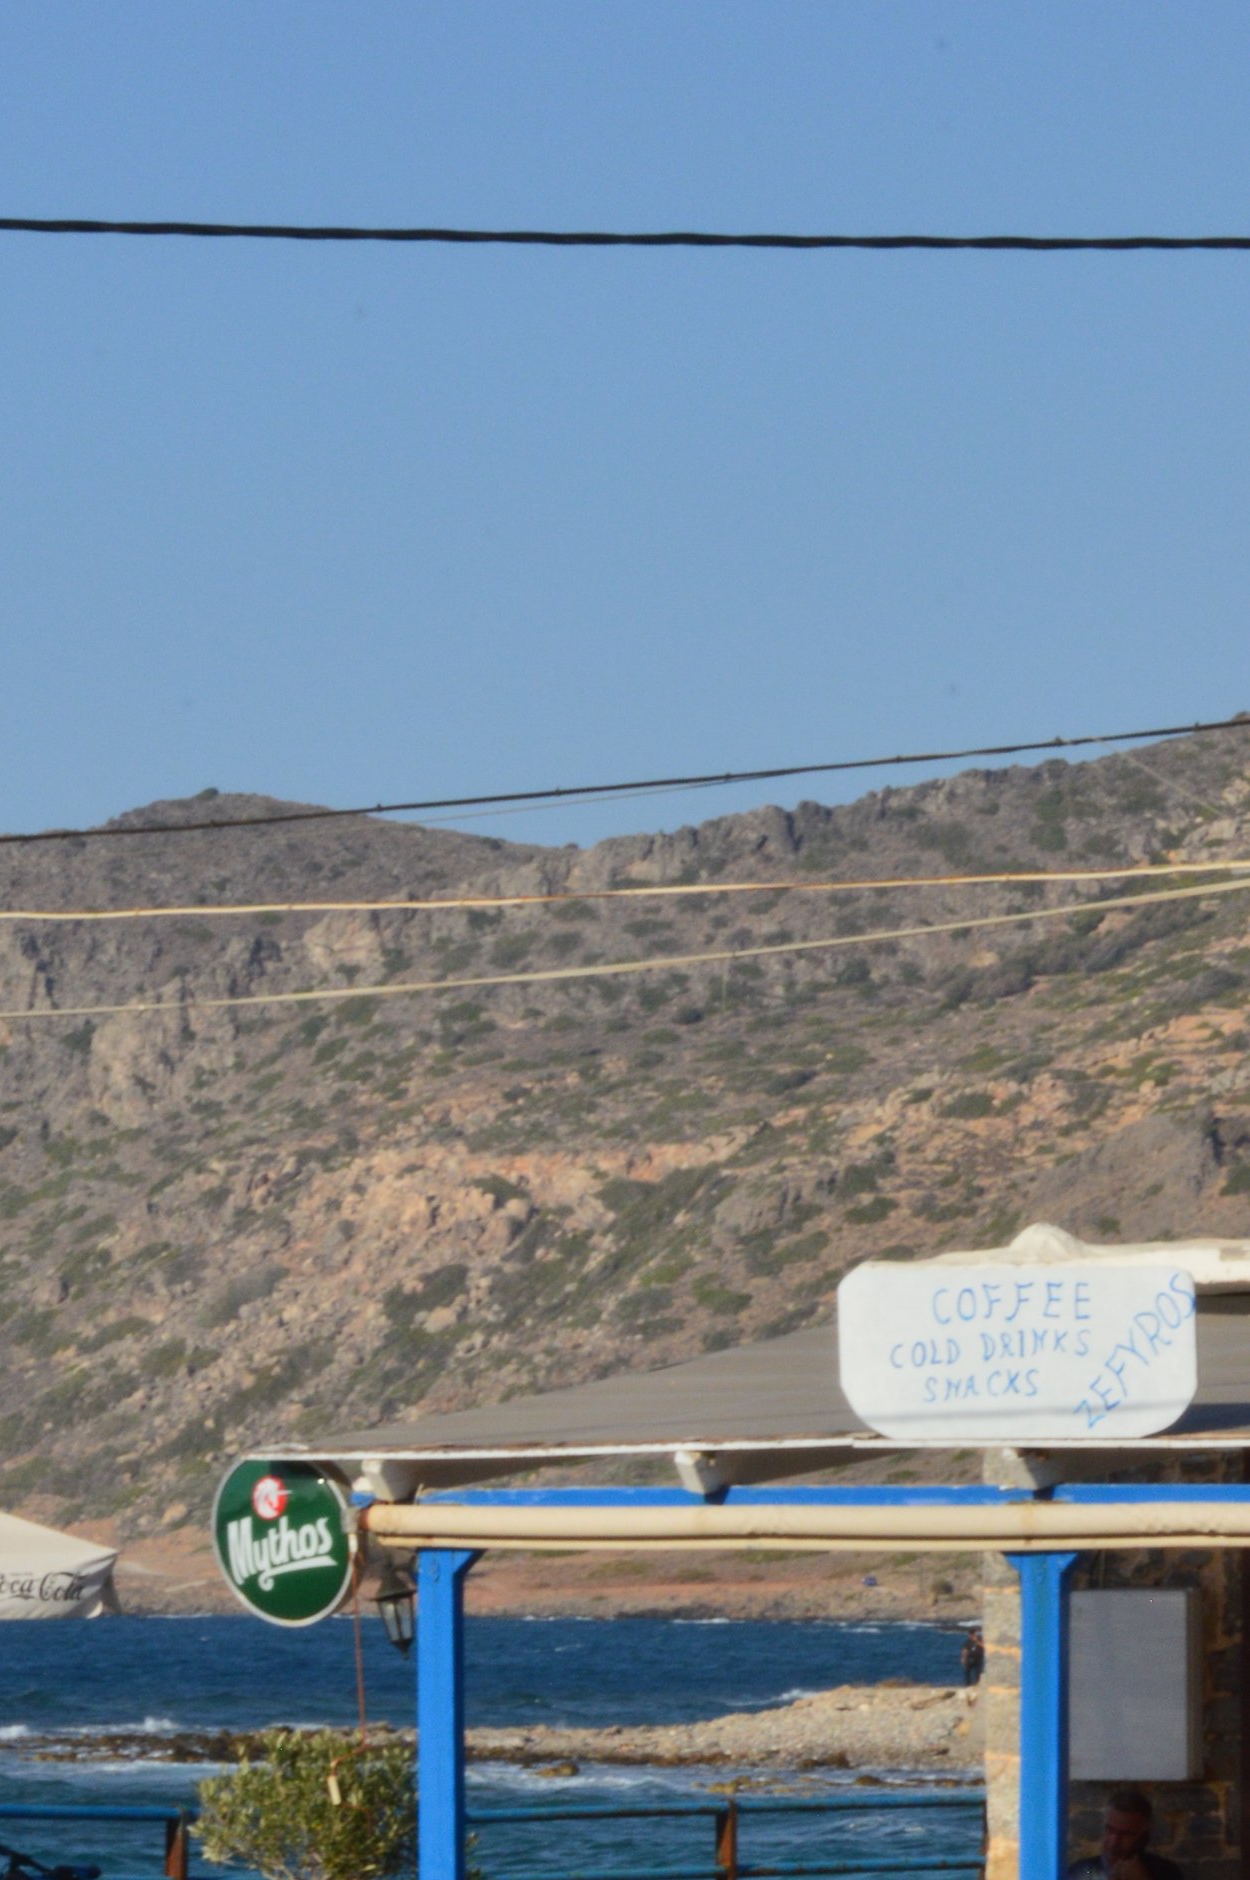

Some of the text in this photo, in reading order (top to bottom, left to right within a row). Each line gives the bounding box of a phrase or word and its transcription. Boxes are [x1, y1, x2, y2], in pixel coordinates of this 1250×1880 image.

[932, 1281, 1091, 1325] COFFEE
[889, 1328, 1091, 1369] COLD DRINKS
[1072, 1272, 1197, 1429] ZEFYROS
[923, 1368, 1039, 1402] SNACKS
[227, 1515, 338, 1592] Mythos
